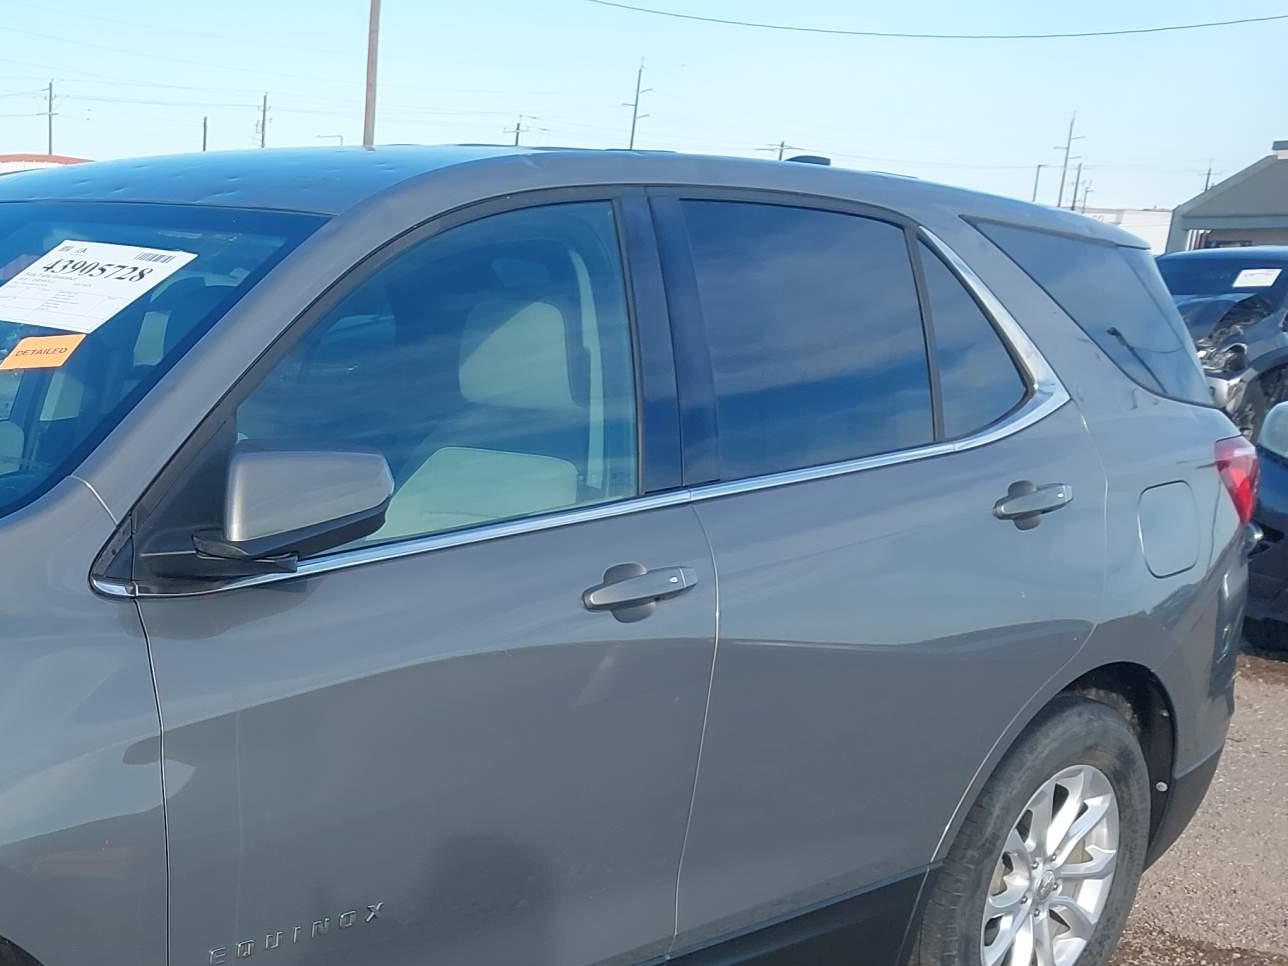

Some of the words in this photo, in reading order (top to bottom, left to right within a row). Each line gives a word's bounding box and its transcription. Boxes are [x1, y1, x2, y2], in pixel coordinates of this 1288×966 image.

[42, 258, 154, 282] 43905728
[15, 347, 68, 357] DETAILED
[208, 902, 384, 966] EQUINOX
